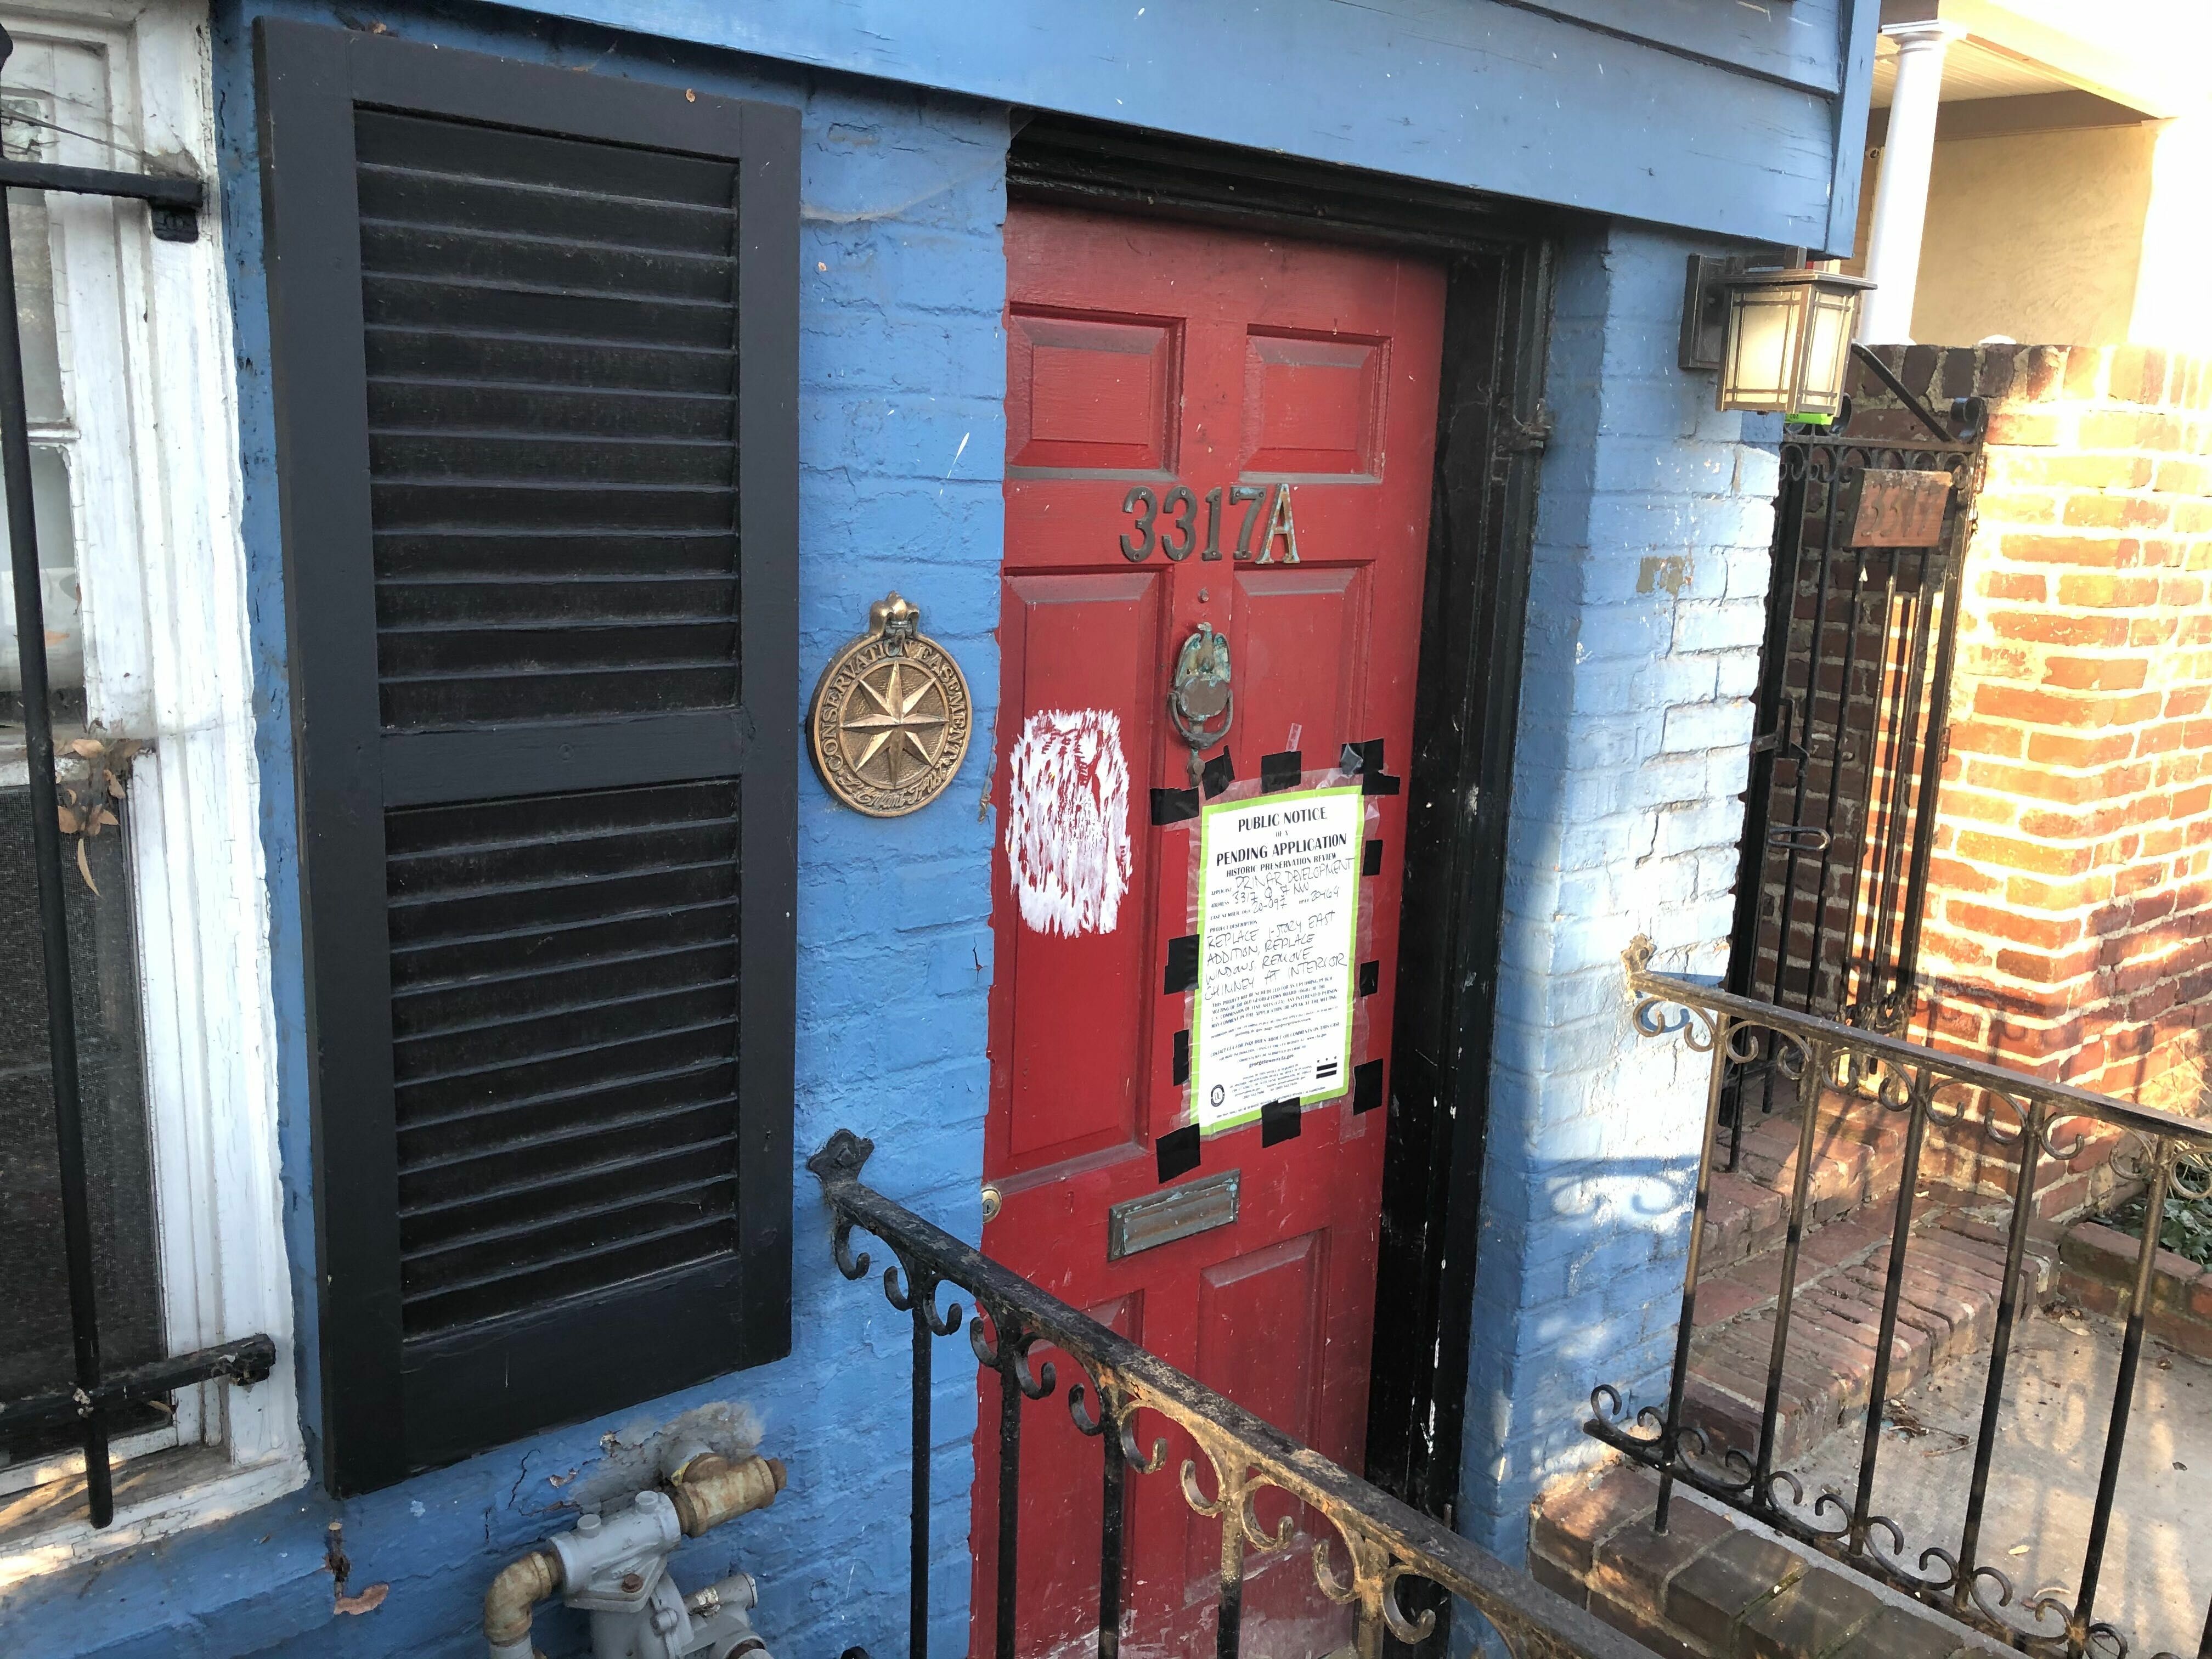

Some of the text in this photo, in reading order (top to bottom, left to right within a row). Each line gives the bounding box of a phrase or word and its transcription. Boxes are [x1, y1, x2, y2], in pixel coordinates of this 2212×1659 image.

[1120, 483, 1300, 564] 3317A
[914, 643, 967, 758] EASEMENT
[1238, 807, 1328, 832] PUBLIC NOTICE
[1216, 833, 1347, 866] PENDING APPLICATION
[1226, 853, 1337, 877] HISTORIC PRESERVATION REVIEW
[1285, 857, 1356, 883] DEVELOPMENT
[1232, 890, 1259, 904] 3317
[1264, 887, 1273, 900] Q
[1206, 929, 1260, 949] REPLACE
[1308, 910, 1335, 929] EAST
[1230, 920, 1257, 929] DESCRIPTION
[1264, 933, 1315, 952] REPLACE
[1262, 946, 1313, 969] REMOVE
[1205, 952, 1347, 1001] CHIMNEY AT INTERIOR
